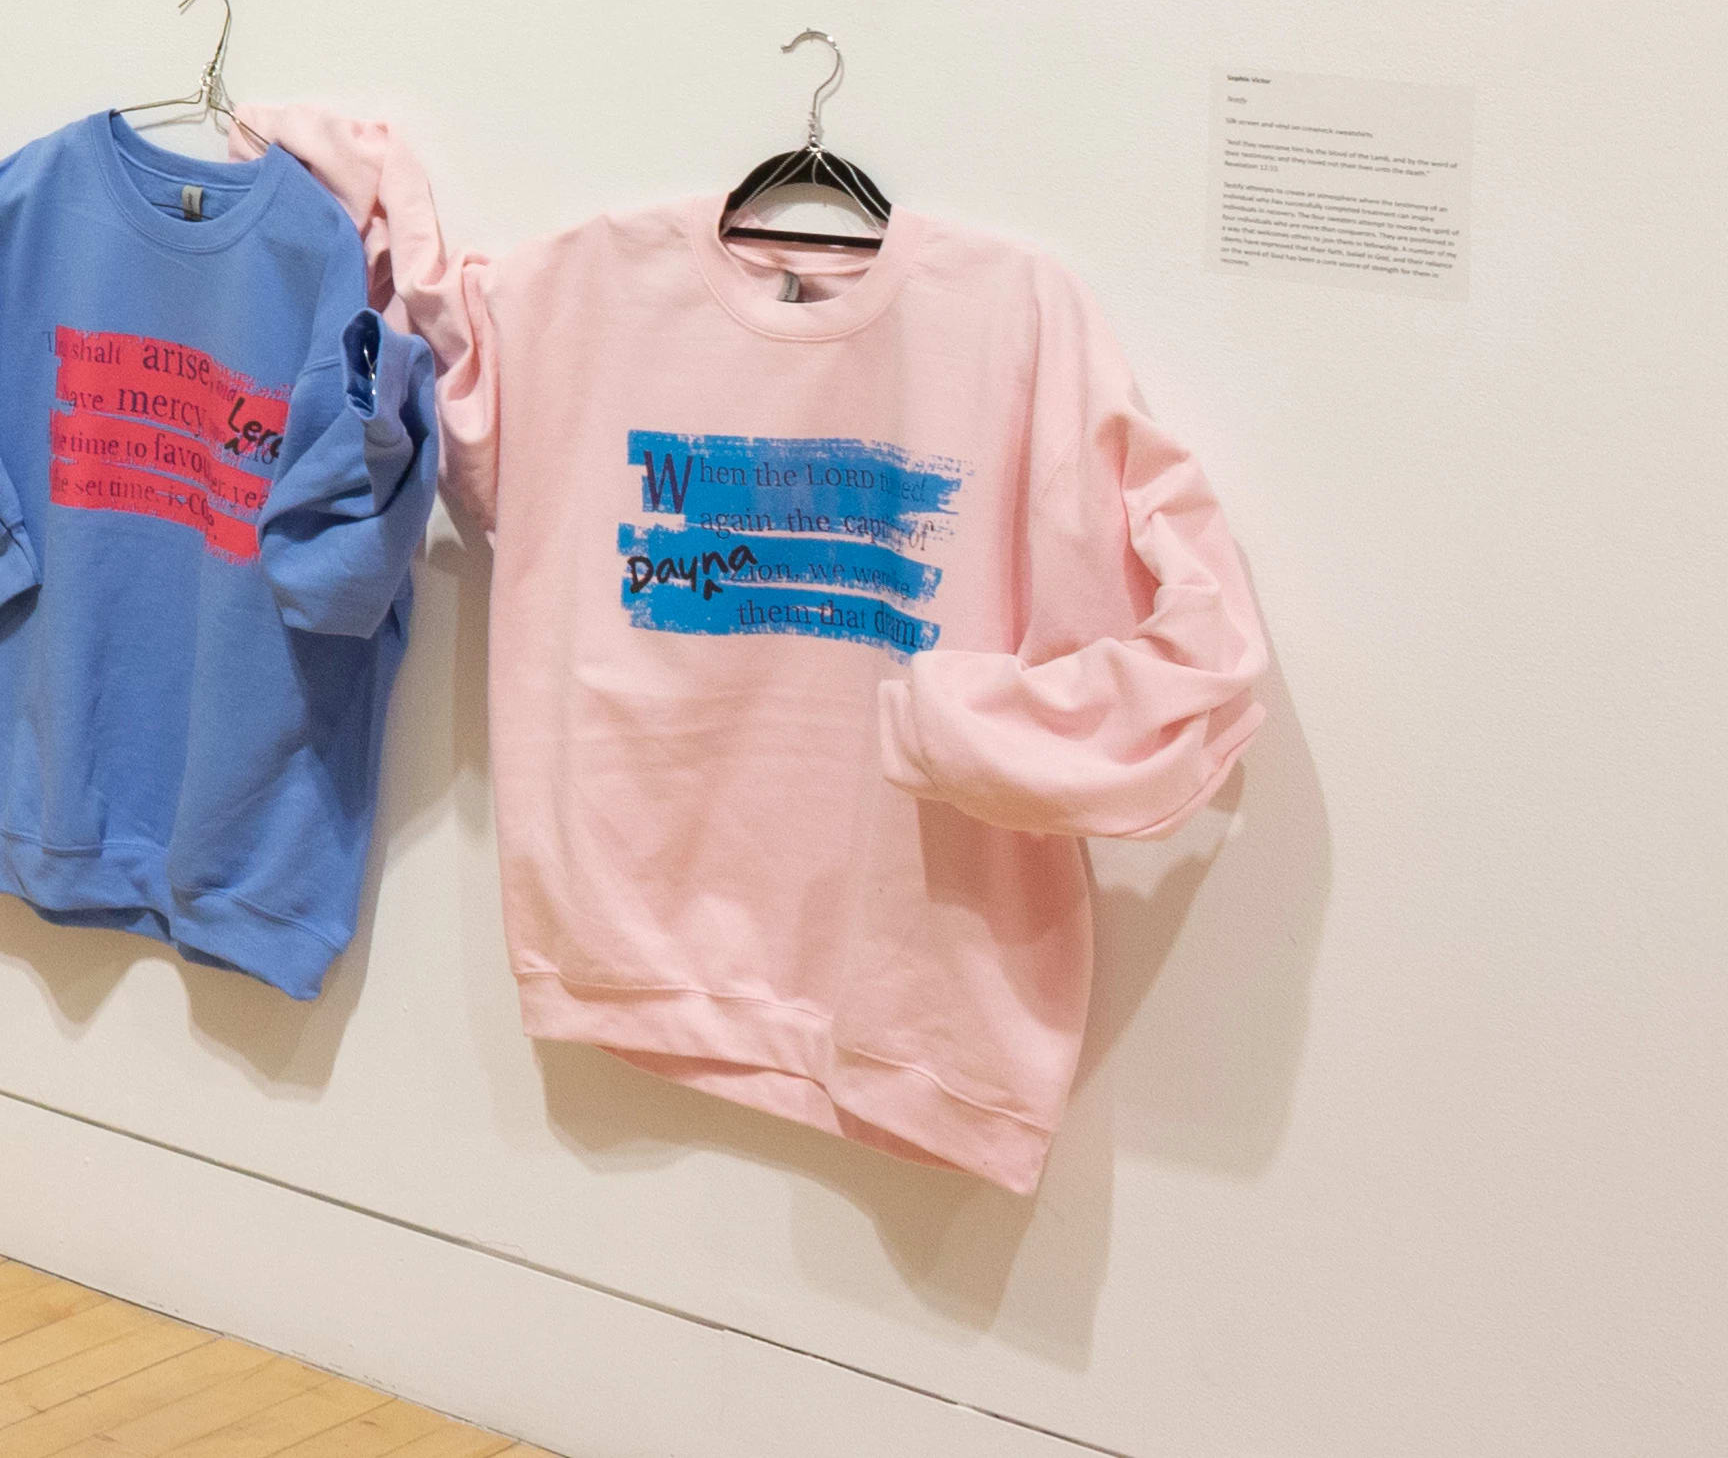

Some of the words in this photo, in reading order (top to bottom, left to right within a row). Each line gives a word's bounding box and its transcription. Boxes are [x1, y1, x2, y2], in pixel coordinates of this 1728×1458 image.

[117, 388, 207, 439] mercy
[71, 432, 120, 457] time
[126, 439, 148, 458] to
[644, 450, 747, 514] When
[754, 462, 798, 489] the
[806, 463, 875, 489] LORD
[700, 508, 773, 540] again
[785, 508, 831, 534] the
[627, 544, 759, 594] Dayna
[809, 561, 846, 581] we
[737, 599, 812, 628] them
[818, 599, 866, 630] that
